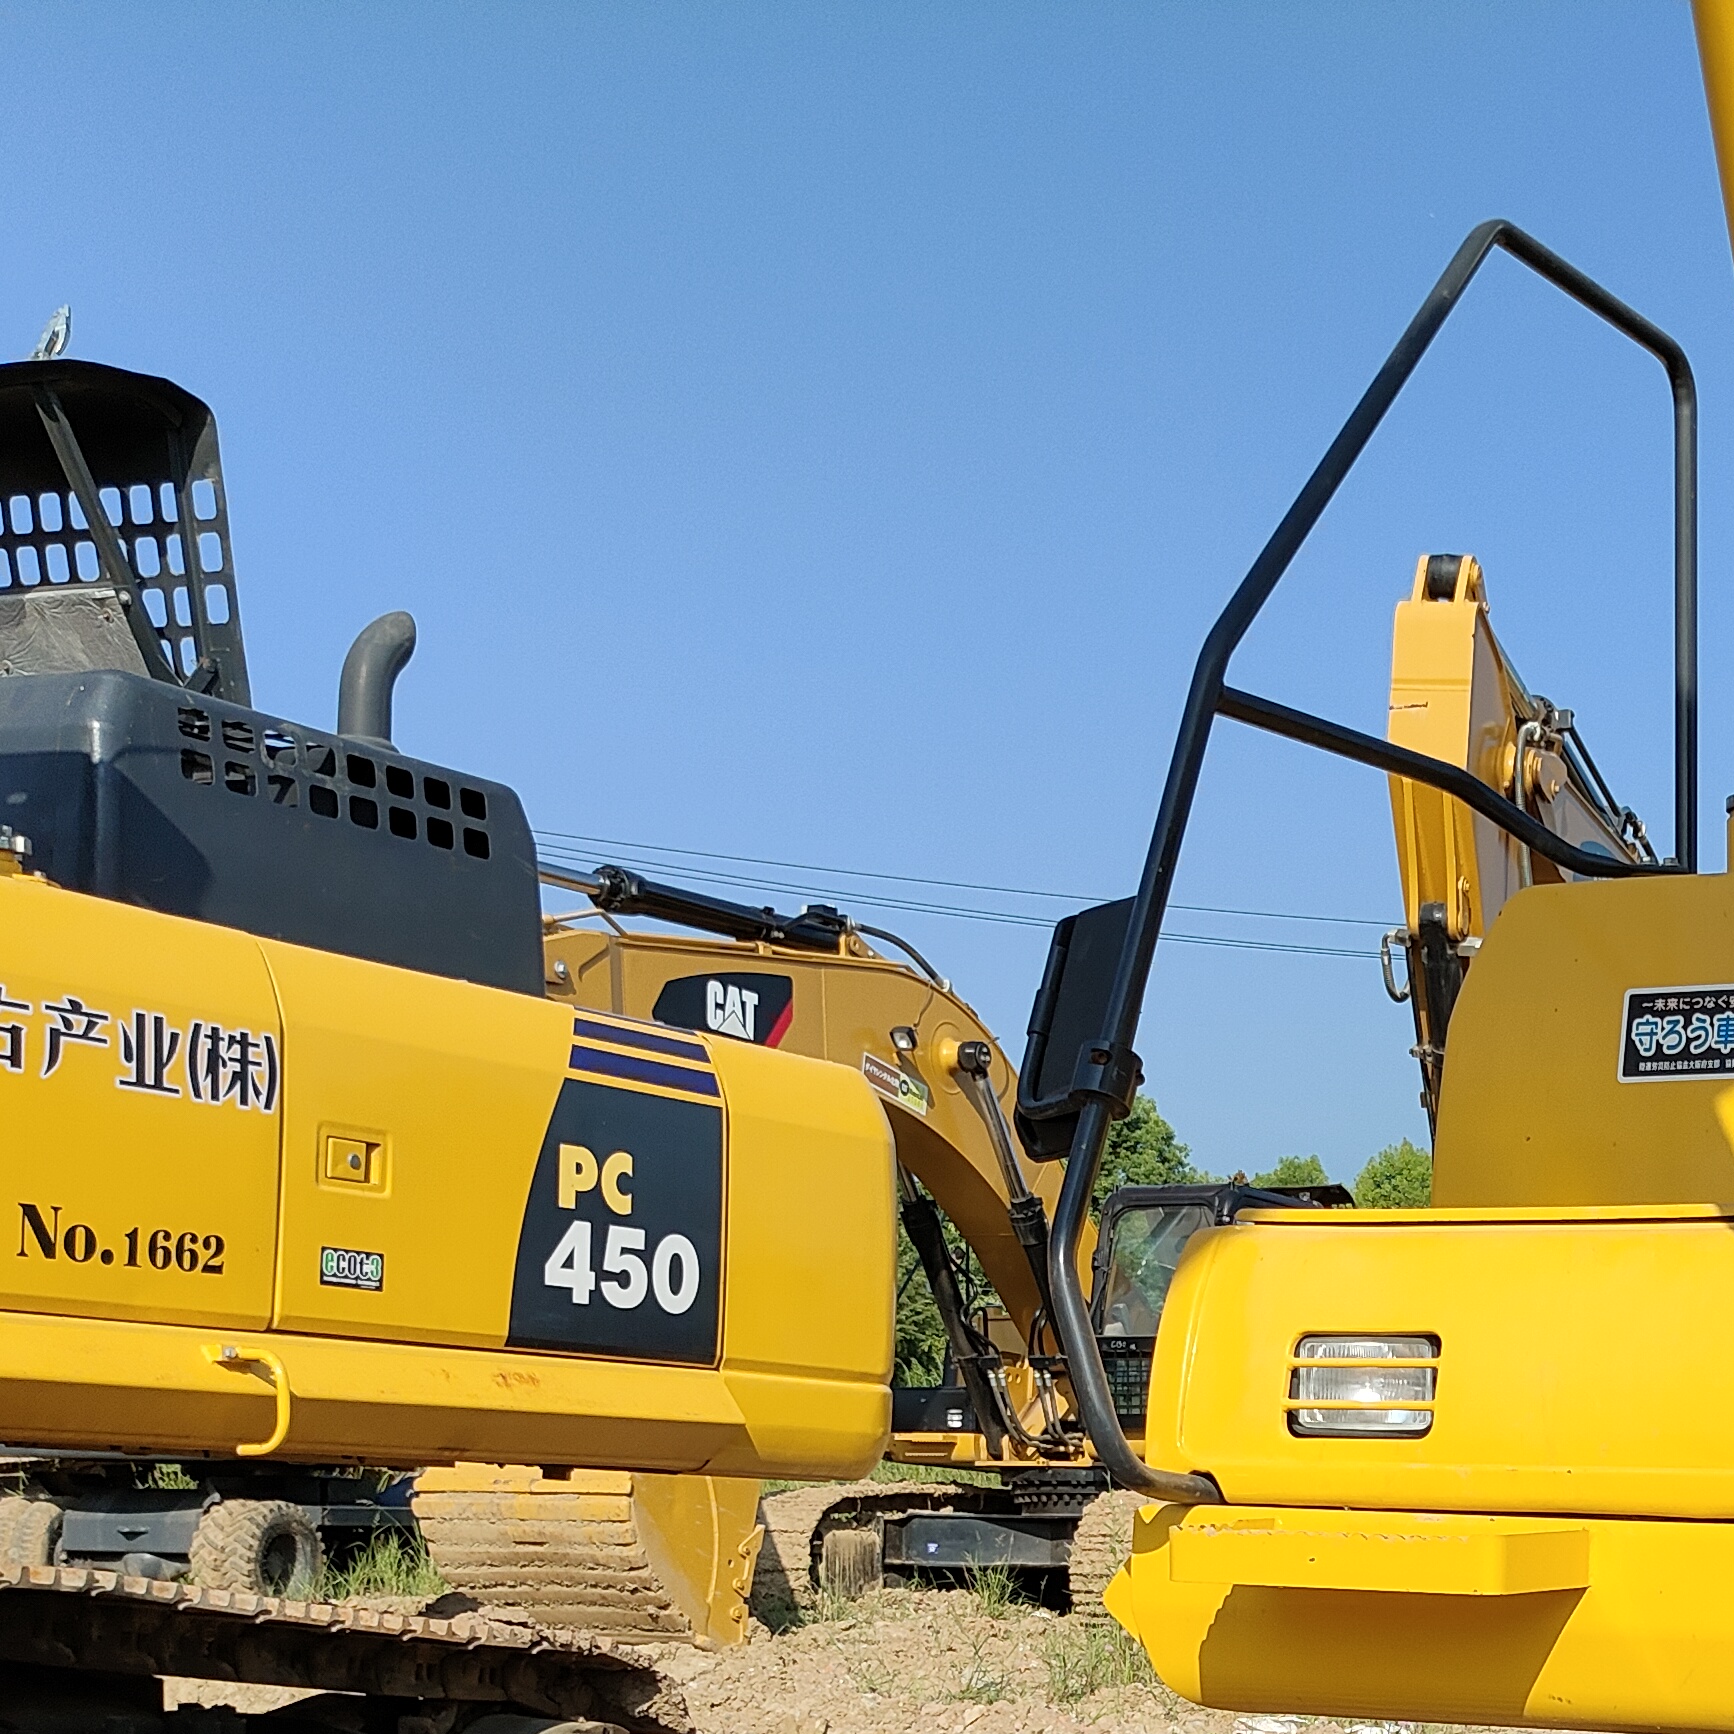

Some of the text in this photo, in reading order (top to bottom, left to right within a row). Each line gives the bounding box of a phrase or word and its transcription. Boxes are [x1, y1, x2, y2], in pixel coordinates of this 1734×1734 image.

[706, 979, 759, 1041] CAT
[558, 1143, 633, 1216] PC
[544, 1220, 700, 1315] 450
